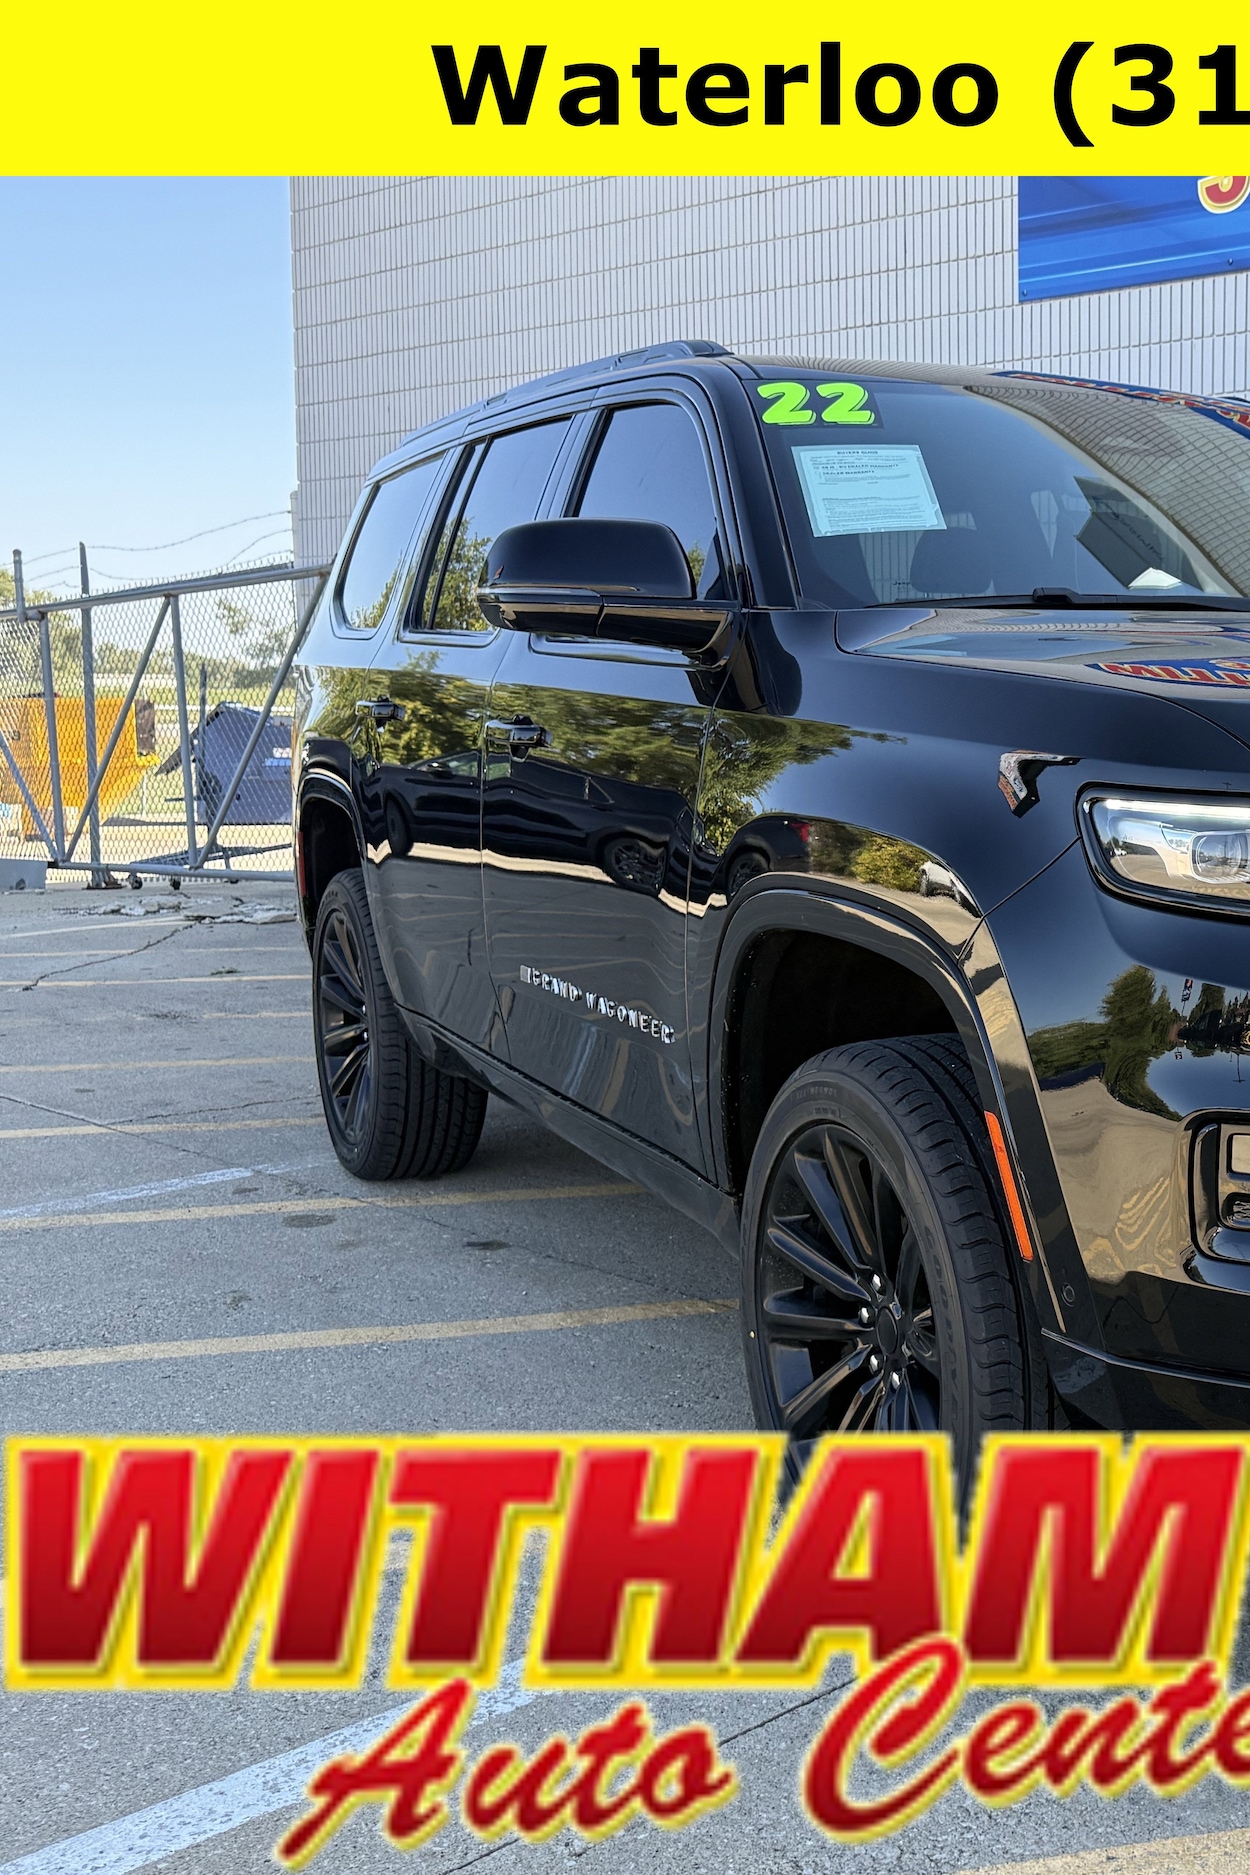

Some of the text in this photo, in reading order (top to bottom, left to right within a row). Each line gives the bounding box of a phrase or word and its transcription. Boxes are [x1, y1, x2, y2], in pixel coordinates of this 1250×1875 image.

[757, 382, 875, 425] 22
[531, 967, 676, 1044] GRAND WAGONEER
